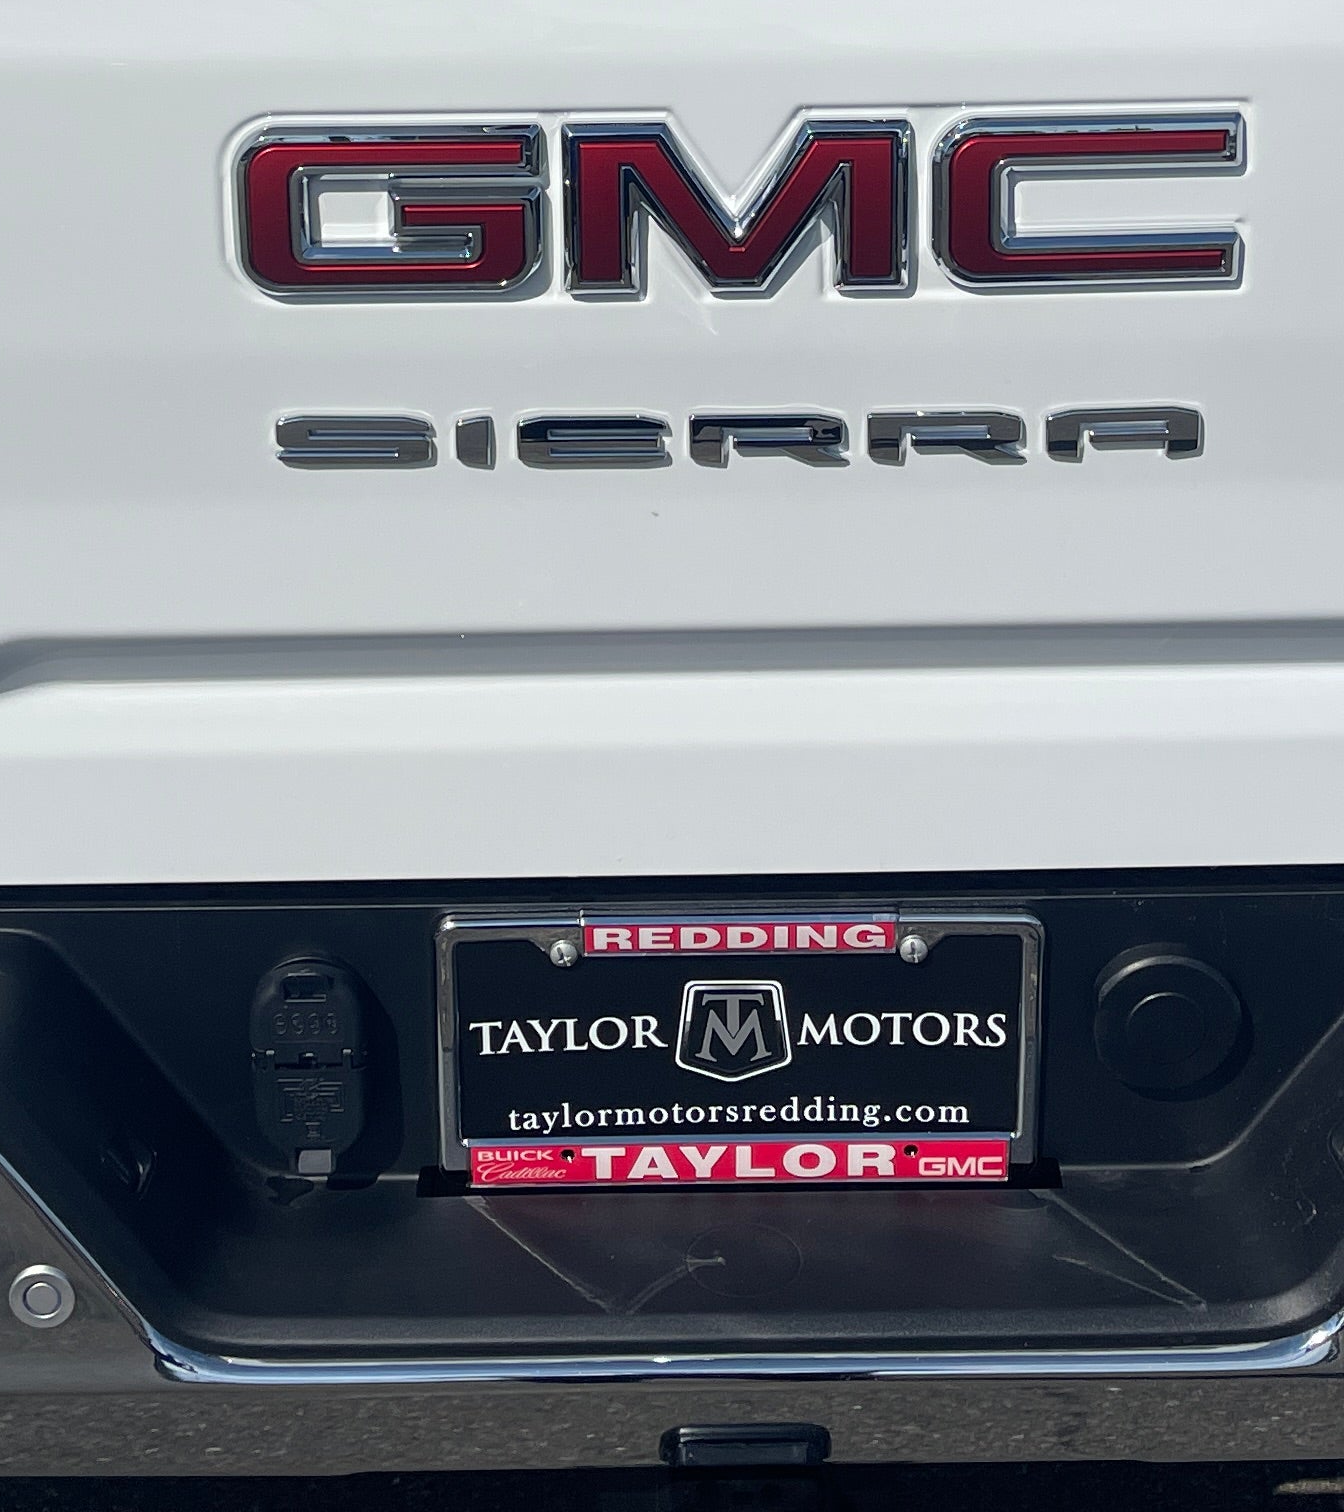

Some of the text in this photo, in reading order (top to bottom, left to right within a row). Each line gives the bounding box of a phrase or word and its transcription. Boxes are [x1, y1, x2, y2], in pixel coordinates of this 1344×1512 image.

[229, 110, 1247, 300] GMC
[273, 404, 1207, 471] SIERRA
[592, 924, 886, 951] REDDING
[468, 1012, 1007, 1056] TAYLOR MOTORS
[508, 1096, 970, 1135] taylormotorsredding.com
[476, 1148, 555, 1163] BUICK
[476, 1161, 568, 1183] Cadillac
[580, 1142, 897, 1181] TAYLOR
[918, 1155, 1003, 1177] GMC
